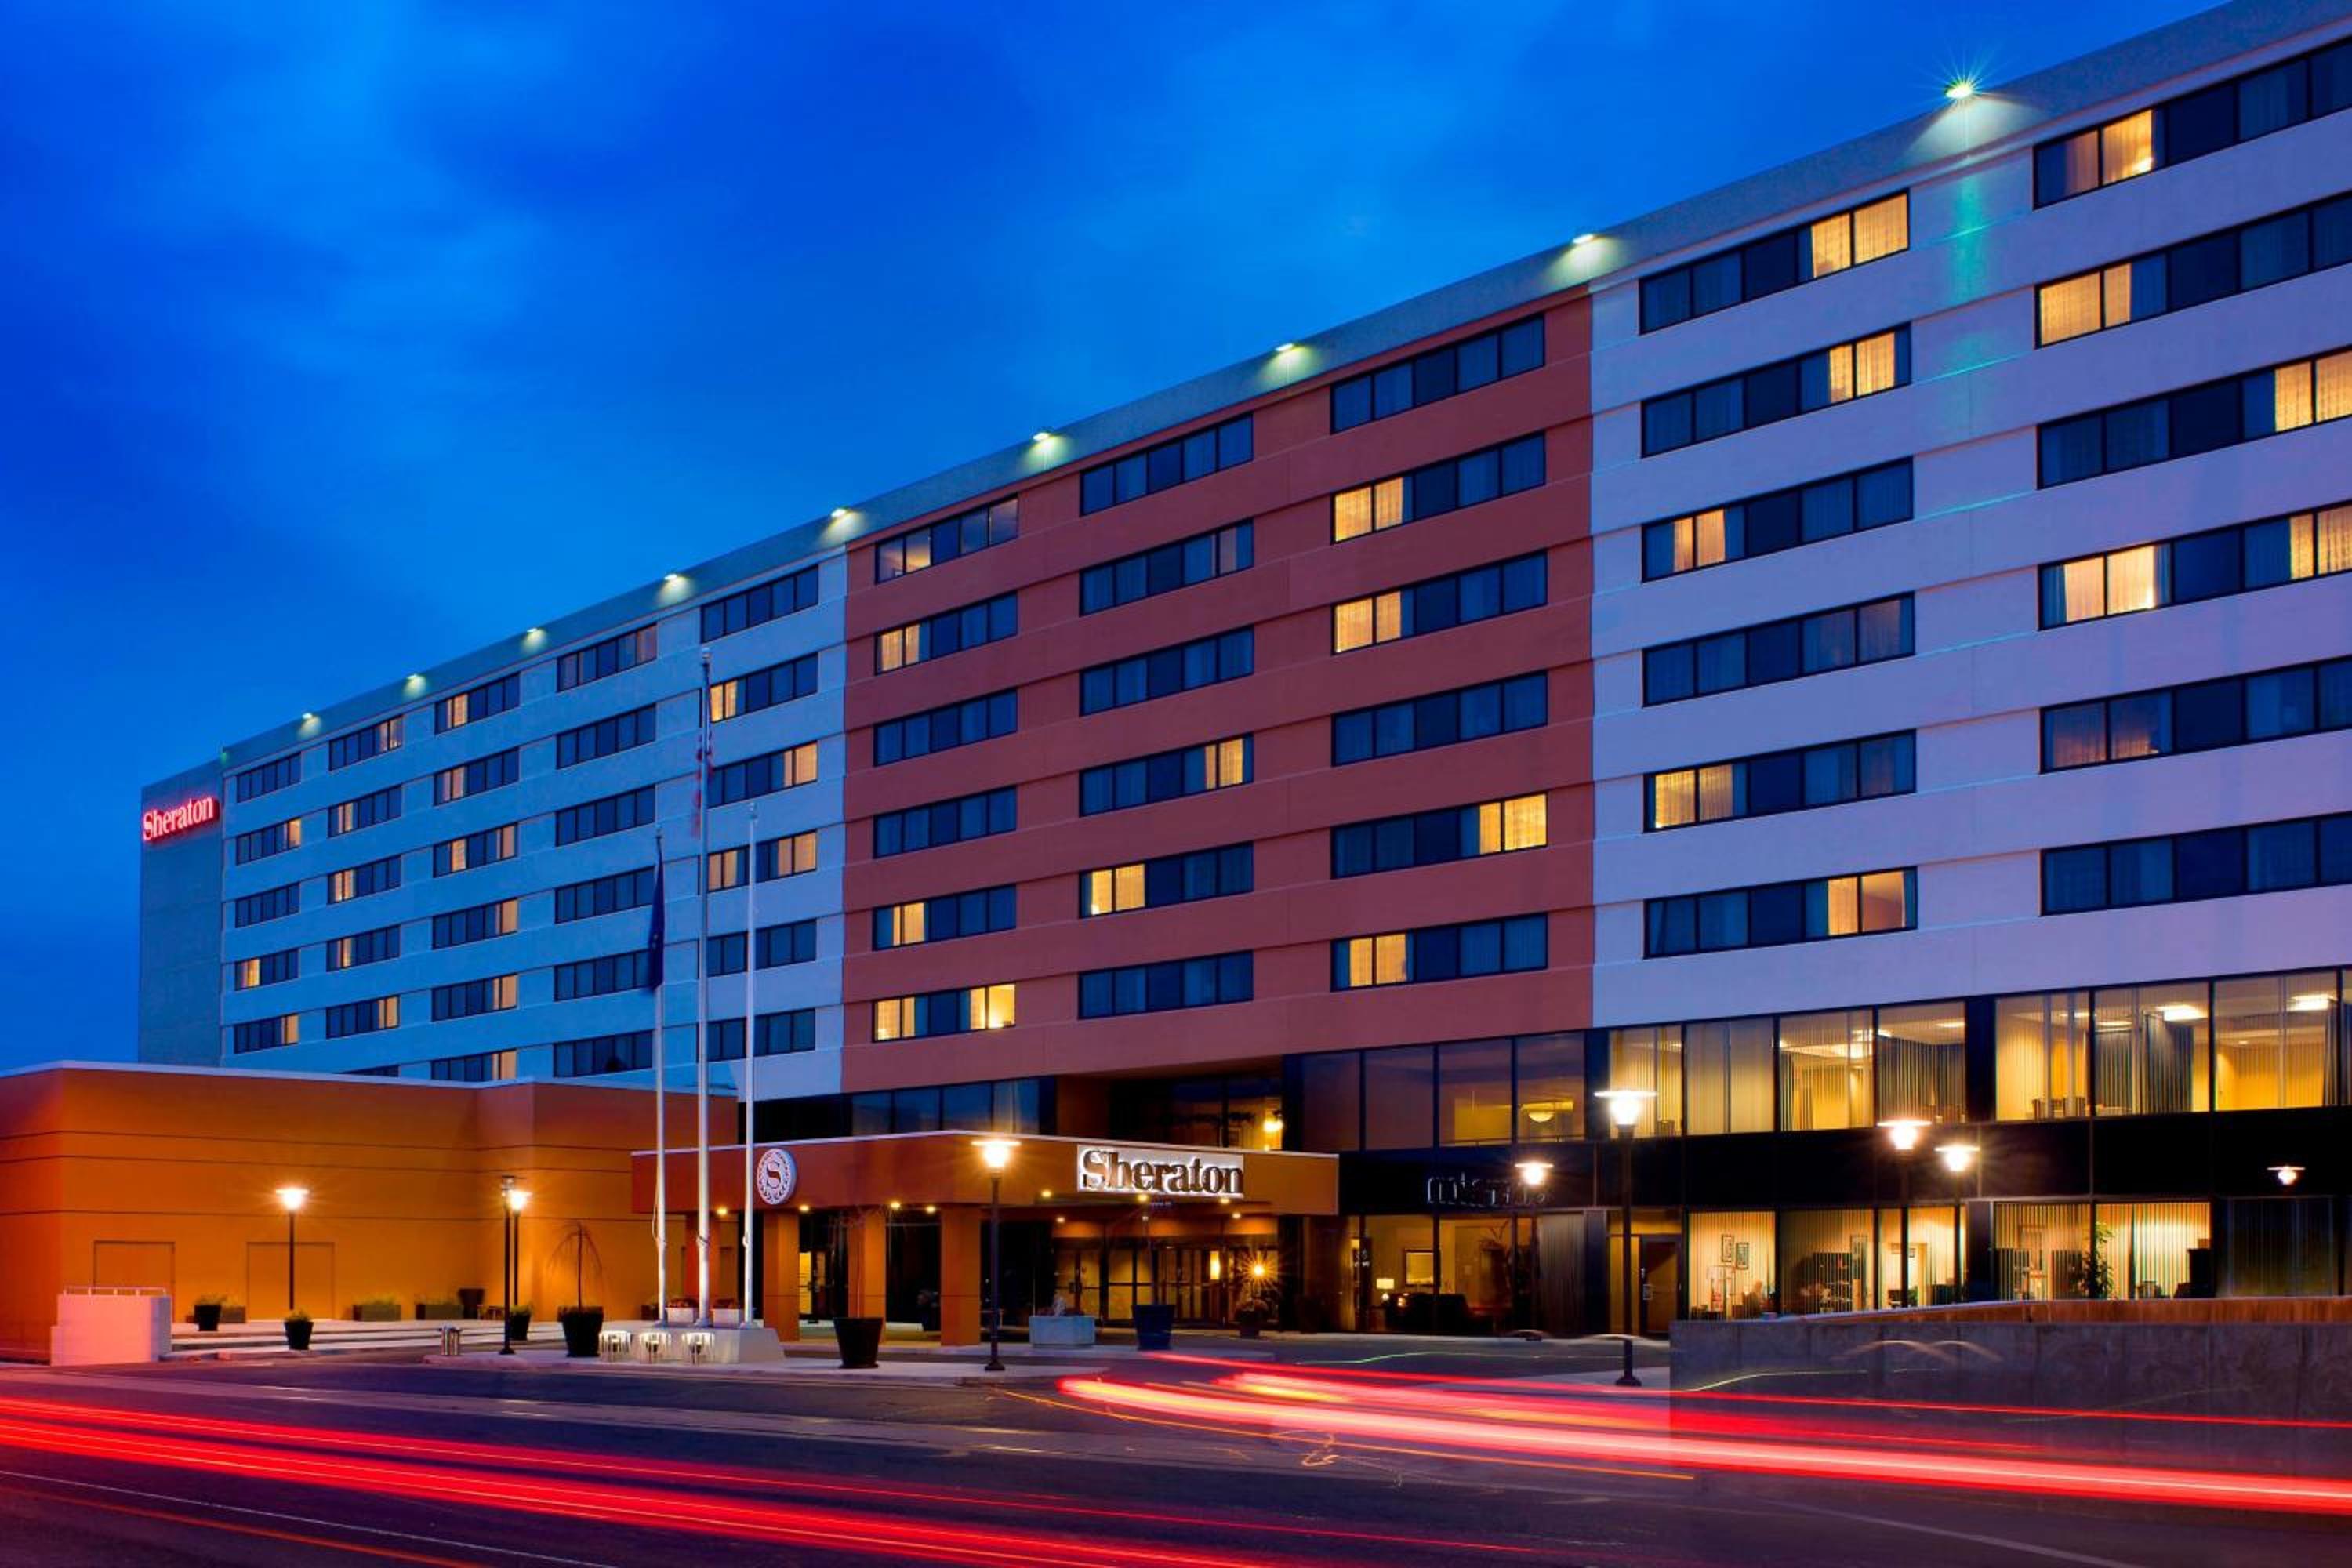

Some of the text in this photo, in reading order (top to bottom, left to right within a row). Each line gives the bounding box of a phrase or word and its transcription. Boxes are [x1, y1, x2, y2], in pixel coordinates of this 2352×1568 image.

[143, 797, 214, 841] Sheraton
[766, 1160, 782, 1189] S
[1082, 1149, 1244, 1194] Sheraton
